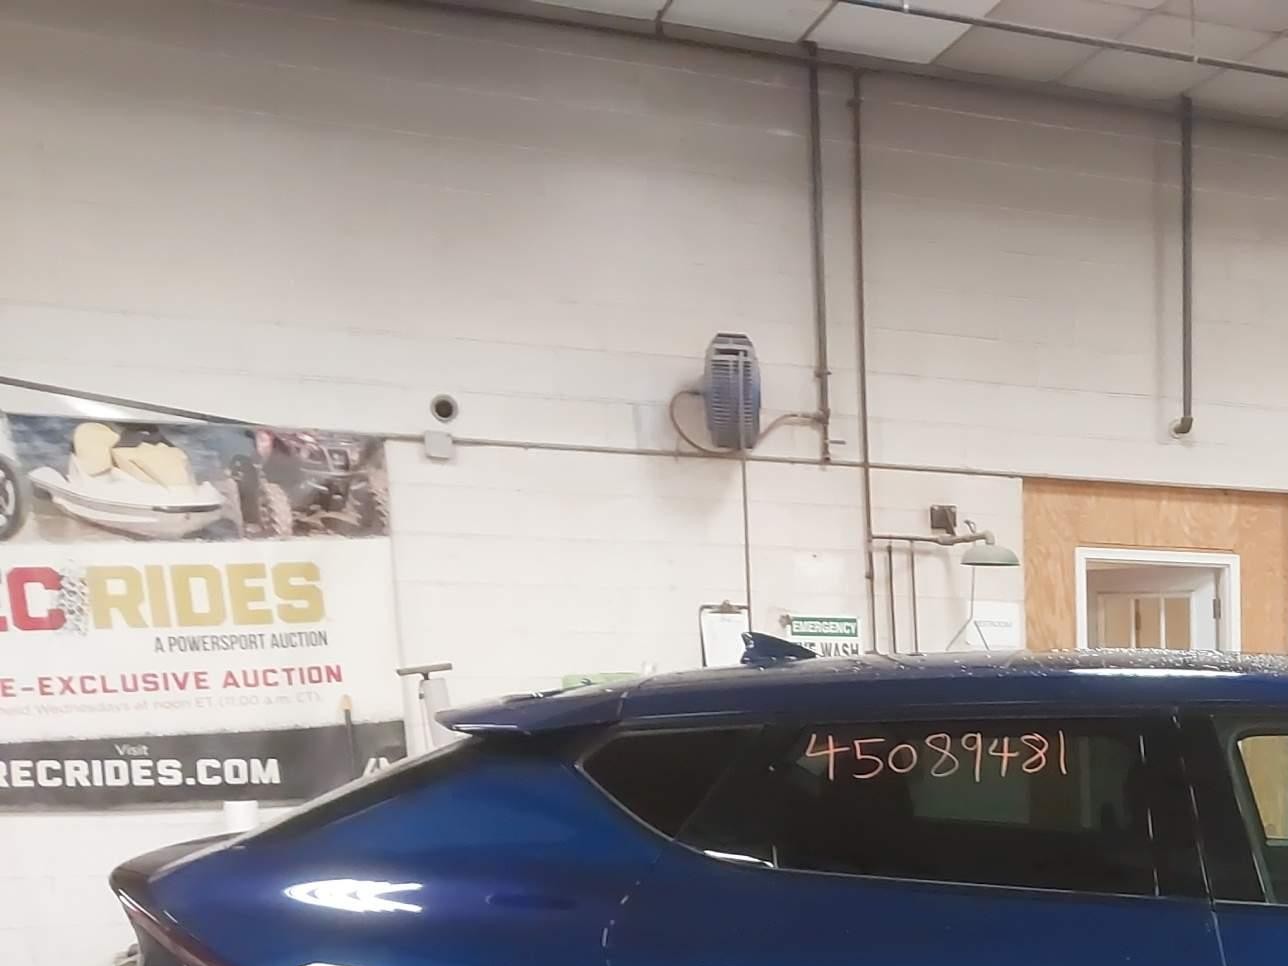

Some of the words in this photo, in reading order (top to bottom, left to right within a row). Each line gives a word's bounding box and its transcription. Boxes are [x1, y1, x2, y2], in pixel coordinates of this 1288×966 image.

[0, 566, 66, 631] C
[87, 562, 326, 629] RIDES
[792, 620, 857, 634] EMERGENCY
[155, 637, 164, 653] A
[168, 634, 266, 652] POWERSPORT
[270, 630, 328, 649] AUCTION
[820, 642, 859, 656] WASH
[0, 670, 210, 698] E-EXCLUSIVE
[222, 664, 343, 689] AUCTION
[114, 743, 149, 756] Visit
[805, 730, 1067, 782] 45089481
